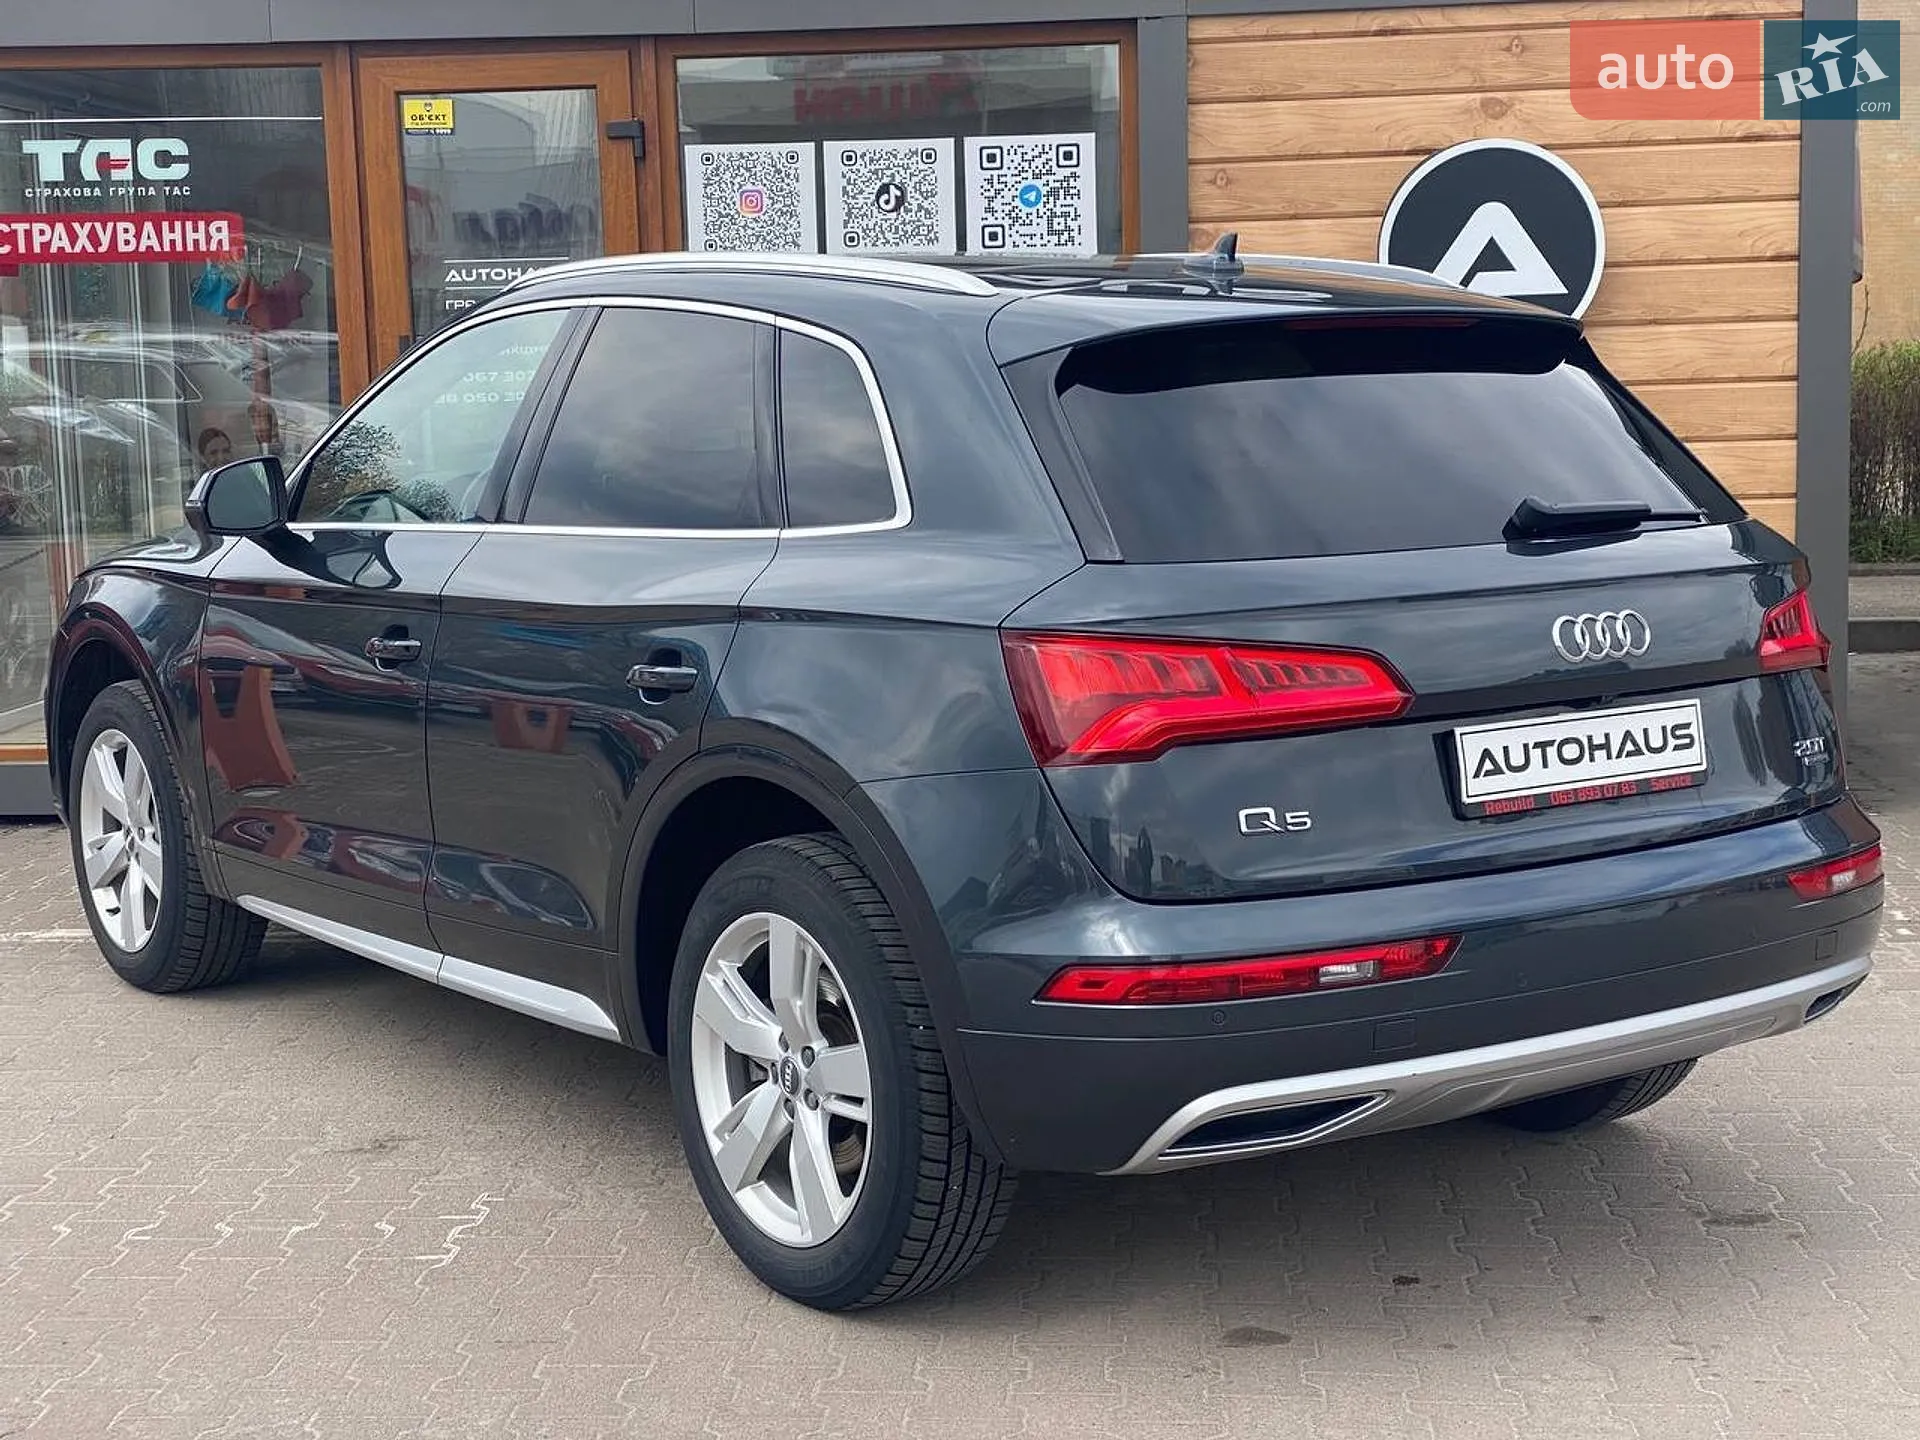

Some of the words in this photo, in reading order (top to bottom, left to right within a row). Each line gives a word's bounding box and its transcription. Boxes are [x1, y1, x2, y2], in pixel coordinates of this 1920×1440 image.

[25, 186, 102, 197] СТРАХОВА
[109, 186, 156, 196] ГРУПА
[163, 185, 191, 195] ТАС
[1472, 722, 1695, 779] AUTOHAUS
[1239, 807, 1312, 834] Q5
